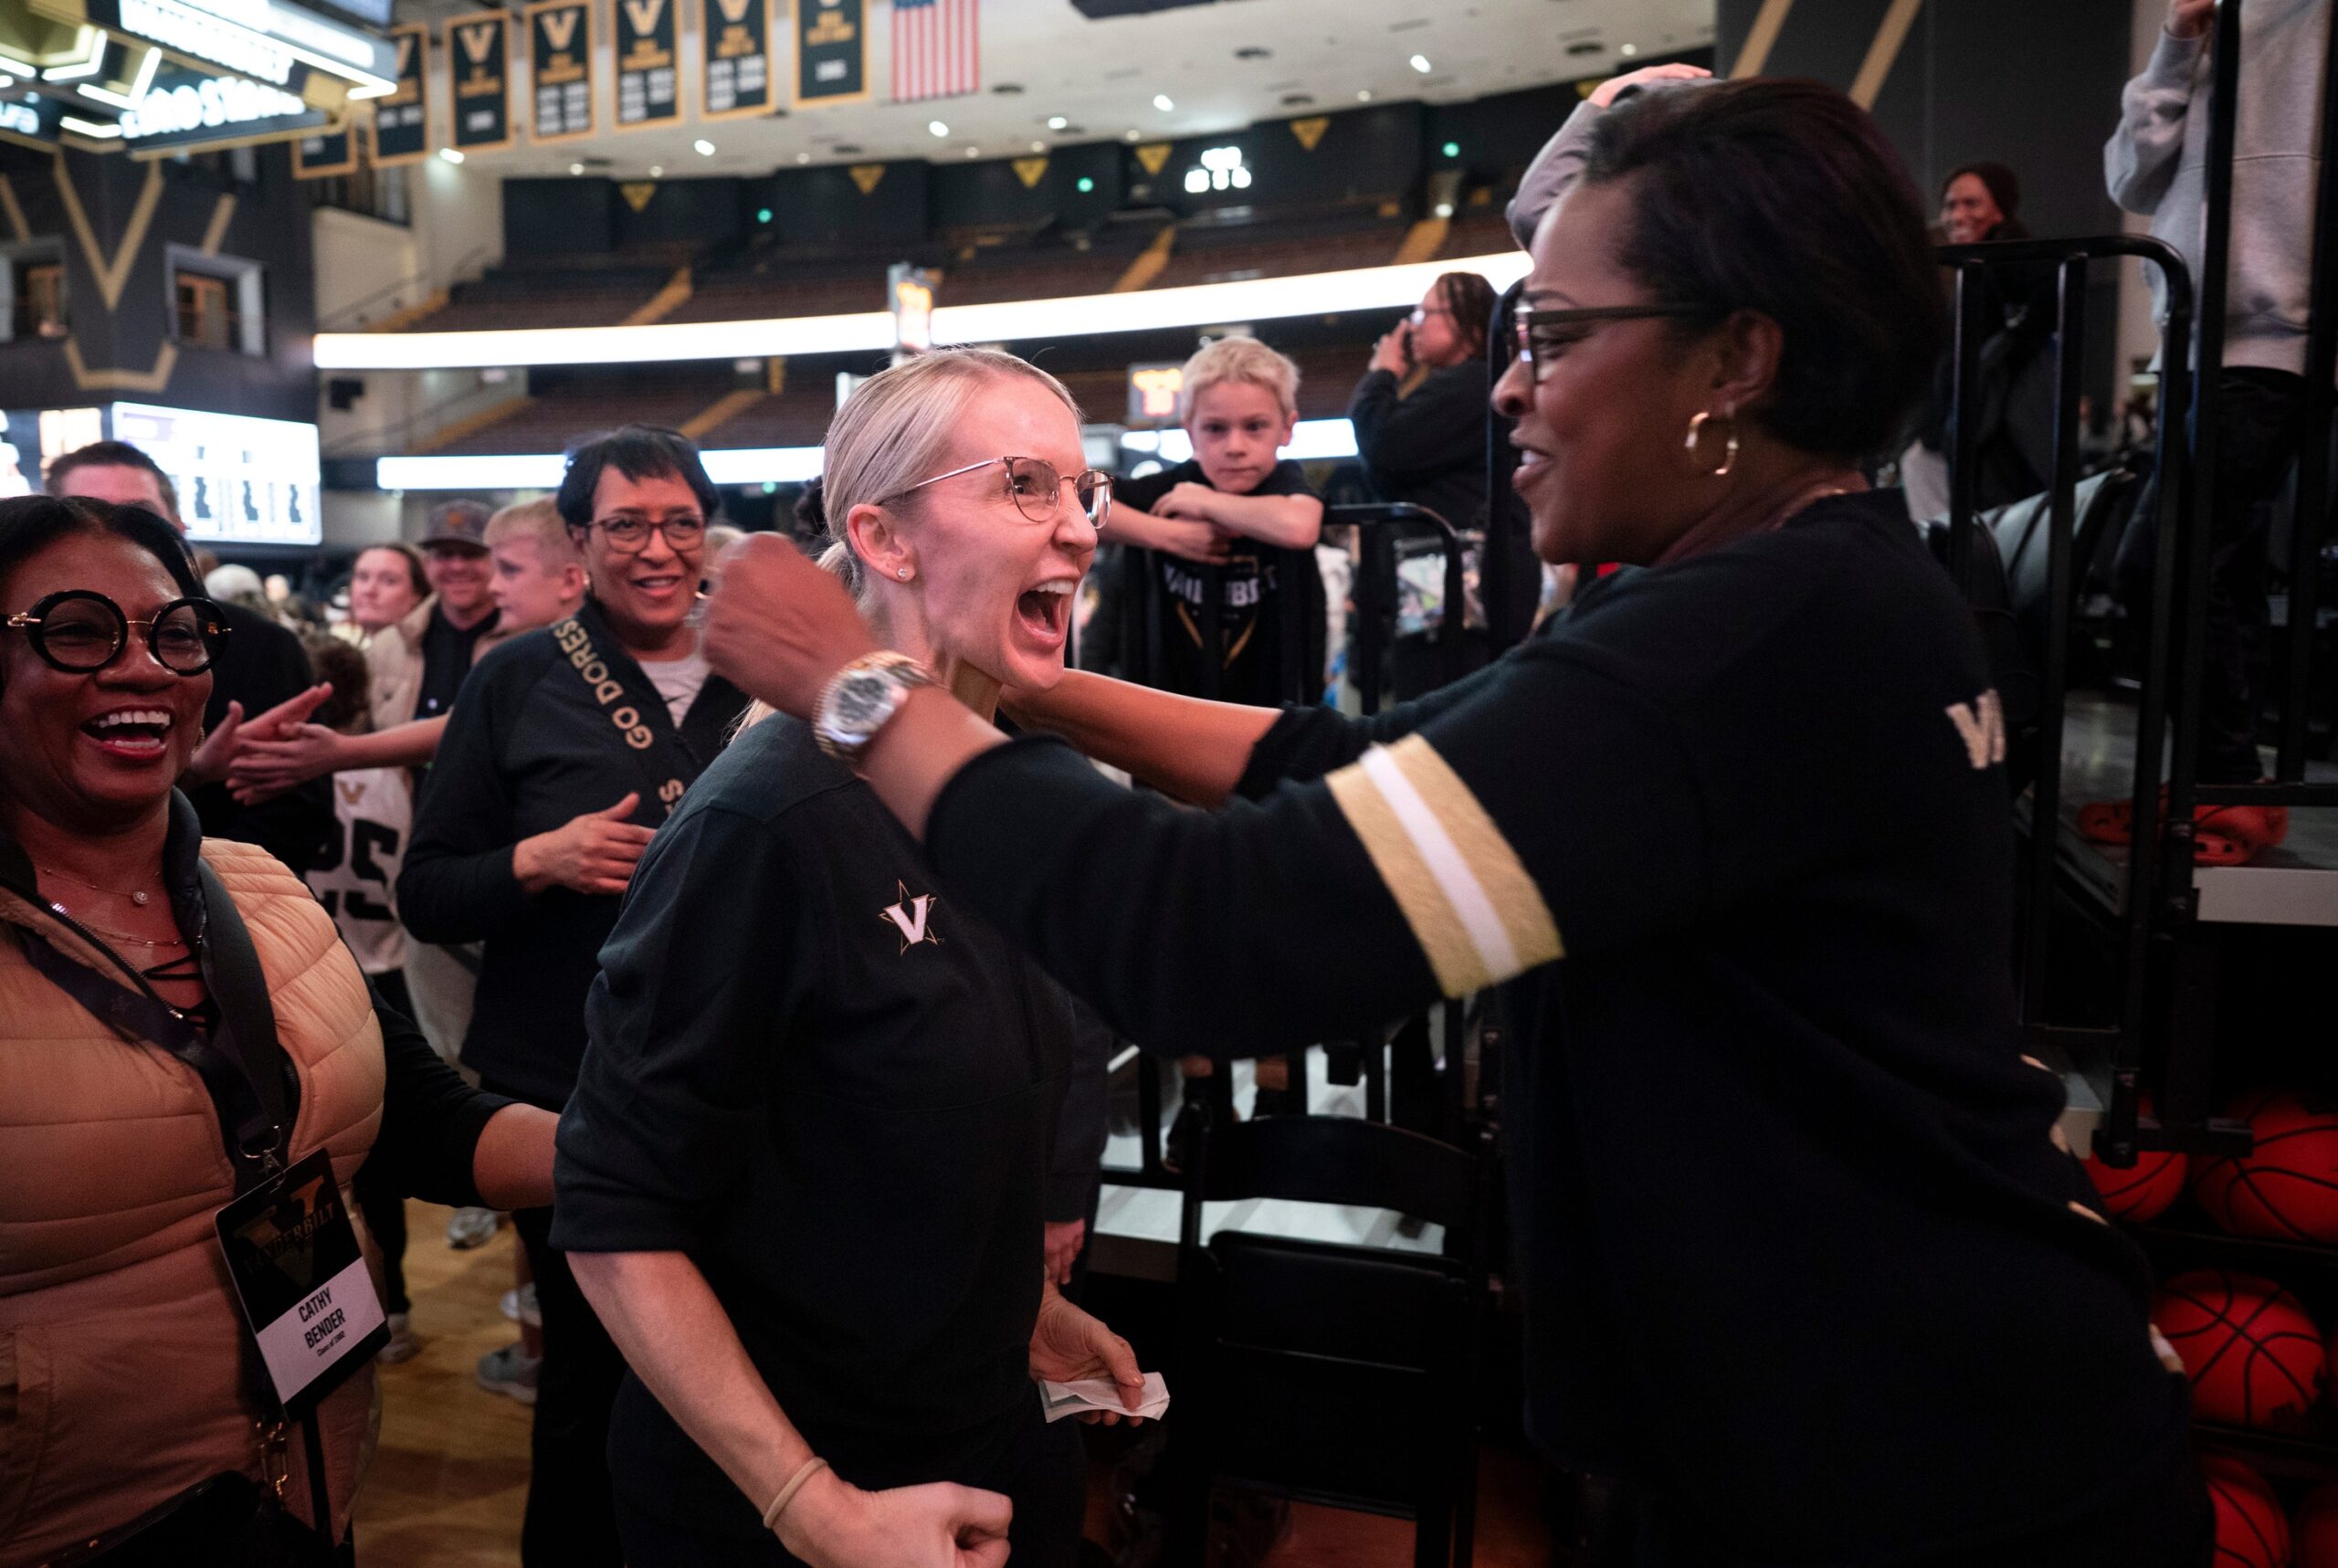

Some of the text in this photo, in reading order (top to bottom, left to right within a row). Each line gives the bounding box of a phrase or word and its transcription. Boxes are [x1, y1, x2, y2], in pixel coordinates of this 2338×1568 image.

[541, 9, 579, 50] V
[622, 0, 664, 36] V
[458, 23, 496, 63] V
[553, 619, 654, 750] GO DORES
[338, 780, 365, 805] V
[883, 893, 930, 945] V
[298, 1286, 332, 1322] CATHY
[304, 1307, 346, 1350] BENDER
